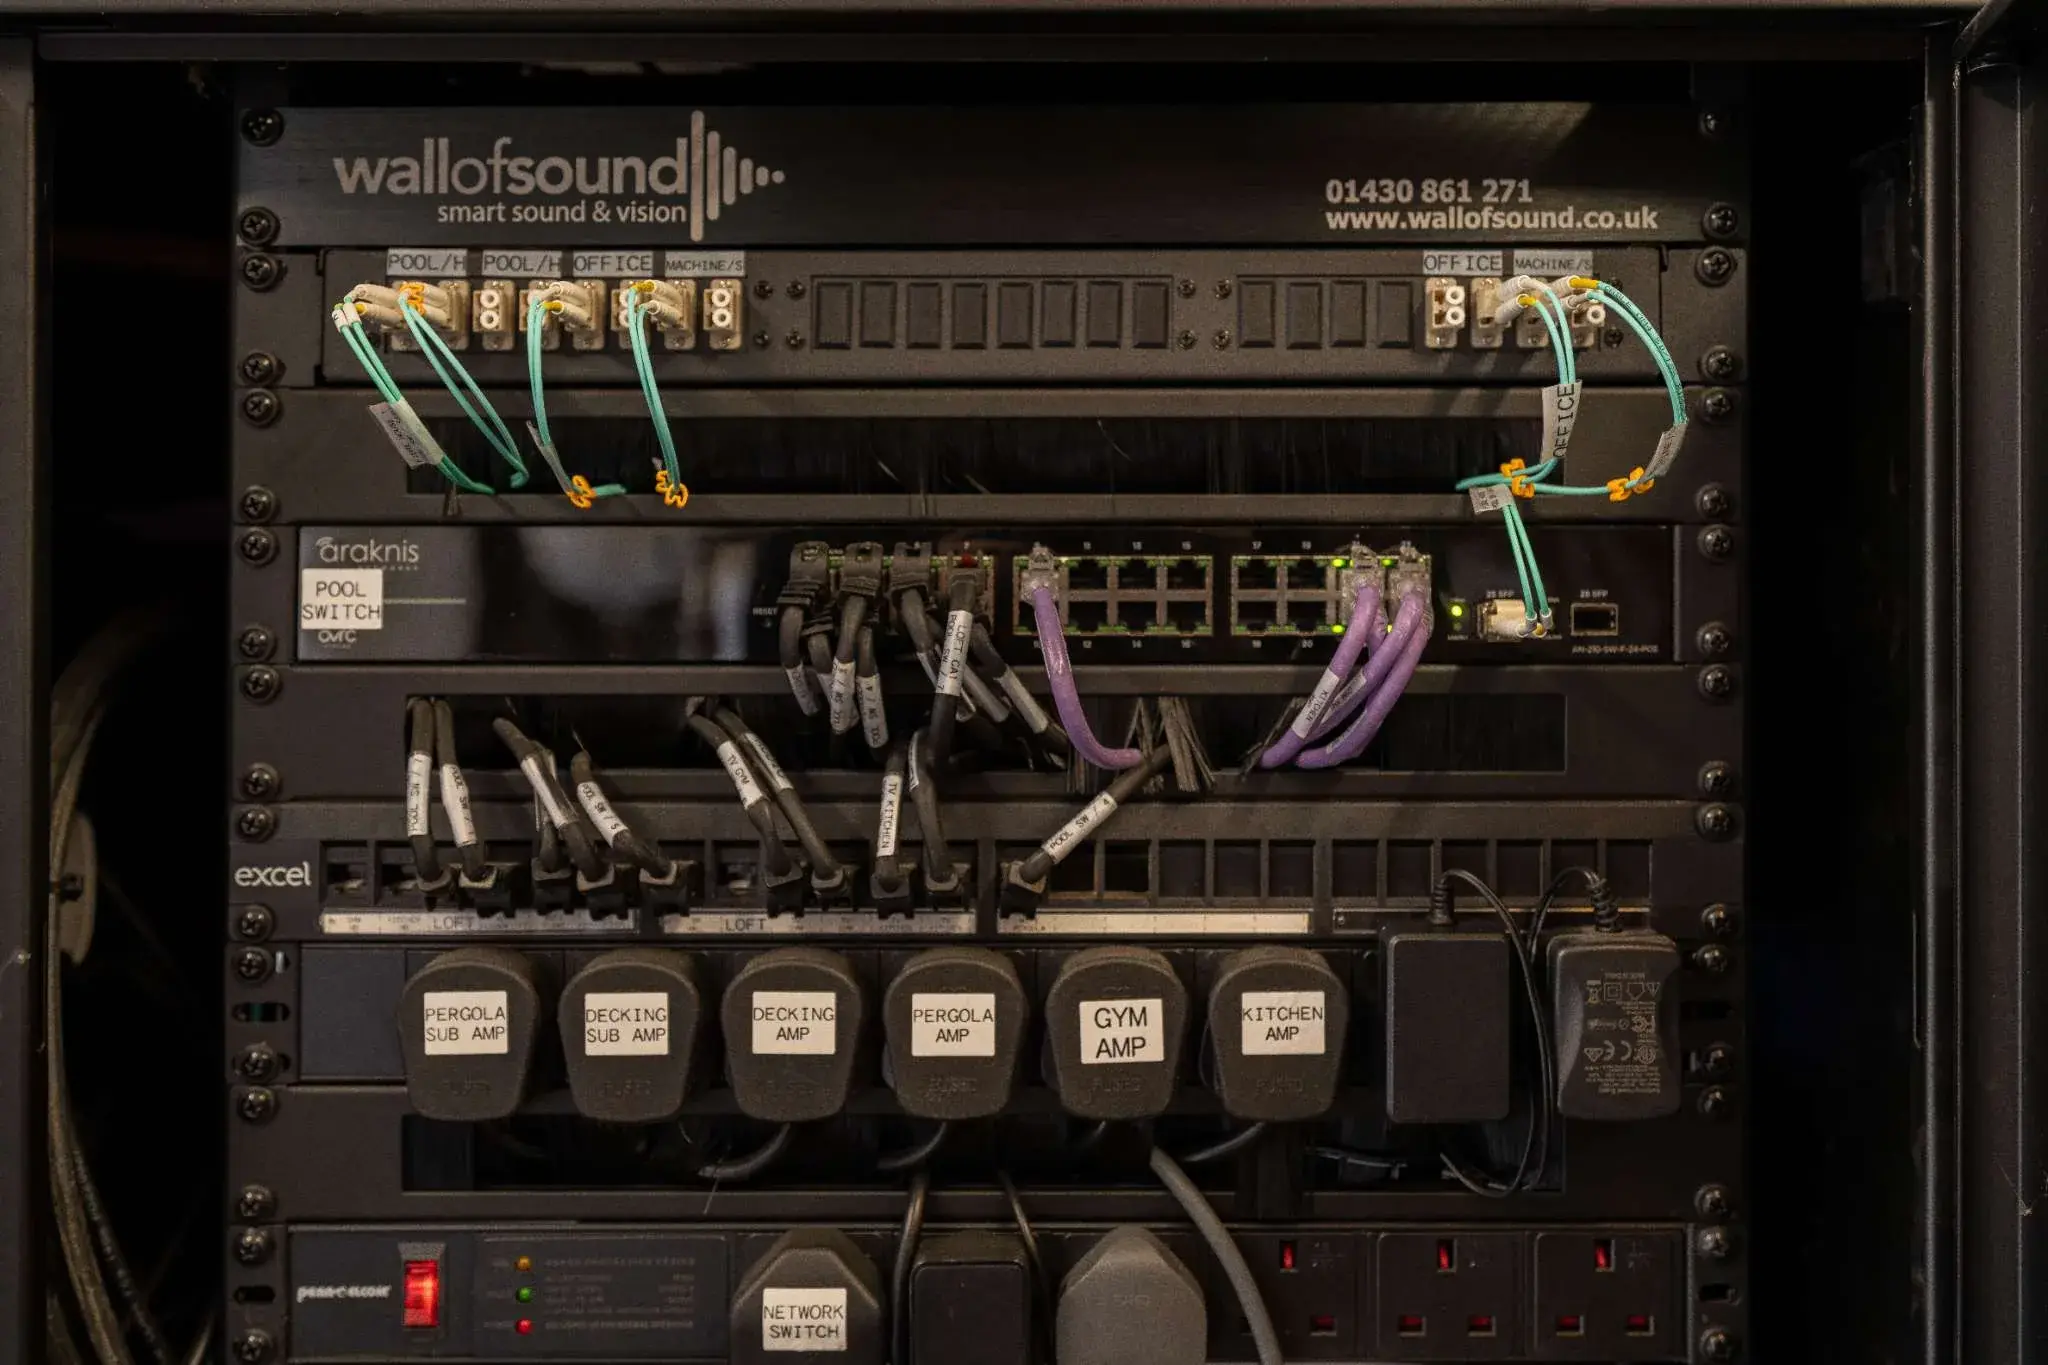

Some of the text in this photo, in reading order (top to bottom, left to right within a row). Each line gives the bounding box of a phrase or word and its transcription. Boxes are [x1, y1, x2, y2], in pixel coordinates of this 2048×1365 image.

[332, 136, 688, 195] wallofsound
[1325, 179, 1533, 204] 01430 861 271
[437, 200, 687, 223] smart sound & vision
[1324, 205, 1659, 230] www.wallofsound.co.uk
[388, 254, 467, 271] POOL/H
[484, 255, 562, 273] POOL/H
[573, 255, 652, 272] OFFICE
[666, 260, 744, 271] MACHINE/S
[1423, 255, 1501, 271] OFFICE
[1515, 258, 1593, 271] MACHINE/S
[1552, 383, 1575, 459] OFFICE
[318, 539, 420, 563] araknis
[315, 581, 367, 598] POOL
[302, 604, 381, 620] SWITCH
[953, 624, 968, 654] LOFT
[727, 754, 751, 785] TV GYM
[880, 782, 899, 850] TV KITCHEN
[1049, 831, 1074, 850] POOL
[1075, 813, 1089, 829] SW
[233, 862, 312, 887] excel
[433, 916, 474, 930] LOFT
[725, 918, 766, 932] LOFT
[424, 1006, 506, 1022] PERGOLA
[585, 1008, 667, 1023] DECKING
[753, 1007, 835, 1021] DECKING
[912, 1008, 994, 1023] PERGOLA
[1093, 1007, 1149, 1030] GYM
[1241, 1006, 1324, 1021] KITCHEN
[425, 1026, 505, 1042] SUB AMP
[586, 1028, 667, 1043] SUB AMP
[775, 1027, 811, 1041] AMP
[935, 1028, 970, 1043] AMP
[1264, 1026, 1300, 1041] AMP
[1095, 1036, 1147, 1059] AMP
[763, 1304, 845, 1321] NETWORK
[769, 1324, 840, 1339] SWITCH
